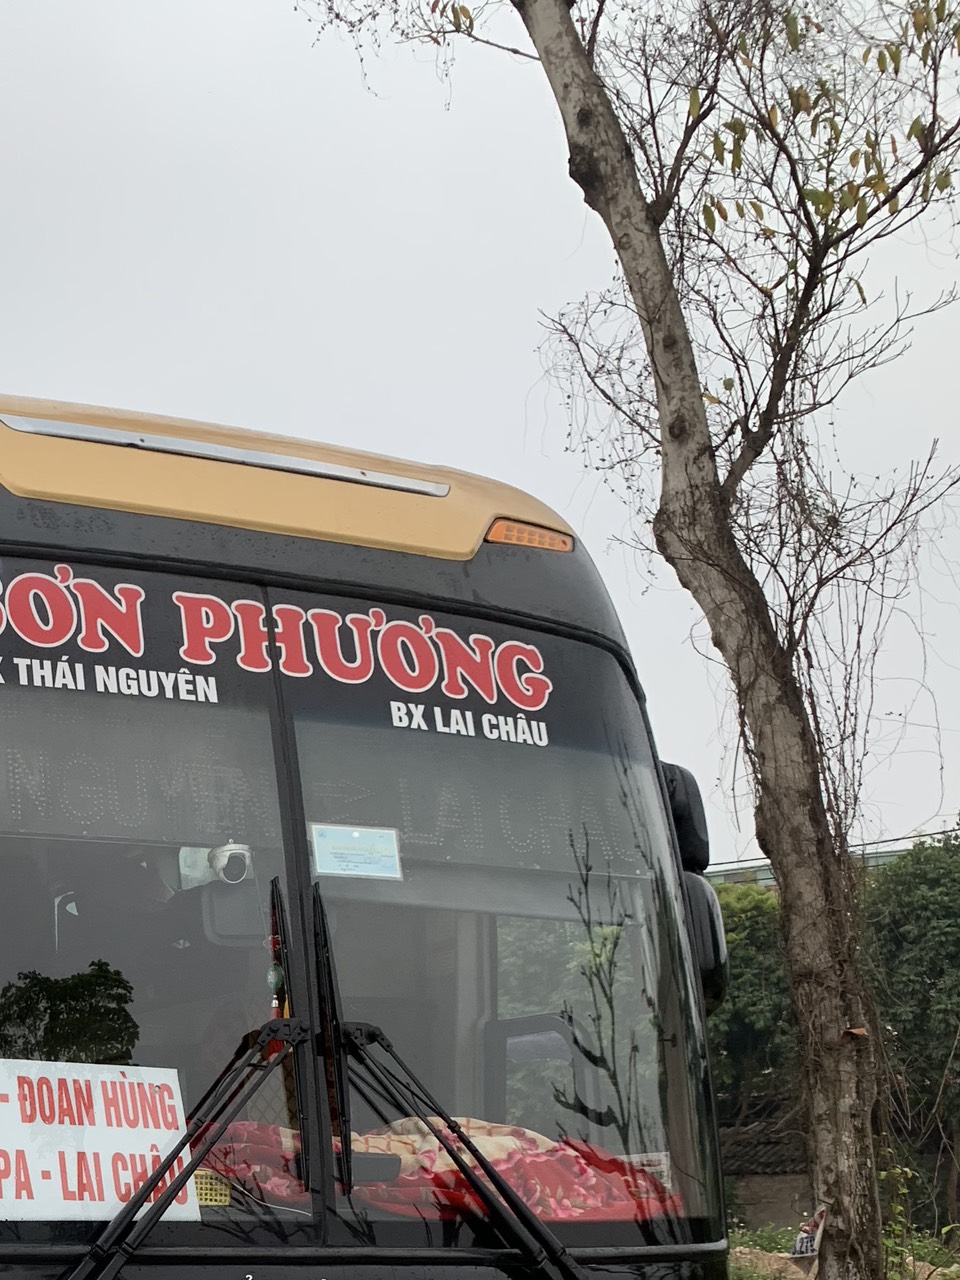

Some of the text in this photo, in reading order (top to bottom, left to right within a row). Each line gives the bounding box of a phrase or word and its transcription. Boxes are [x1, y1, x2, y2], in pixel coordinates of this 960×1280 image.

[172, 591, 553, 710] PHƯƠNG
[13, 655, 85, 691] THÁI
[96, 665, 218, 703] NGUYÊN
[390, 700, 549, 746] BX LAI CHÂU
[18, 1075, 96, 1126] ĐOAN
[100, 1071, 179, 1130] HÙNG
[58, 1150, 105, 1201] LAI
